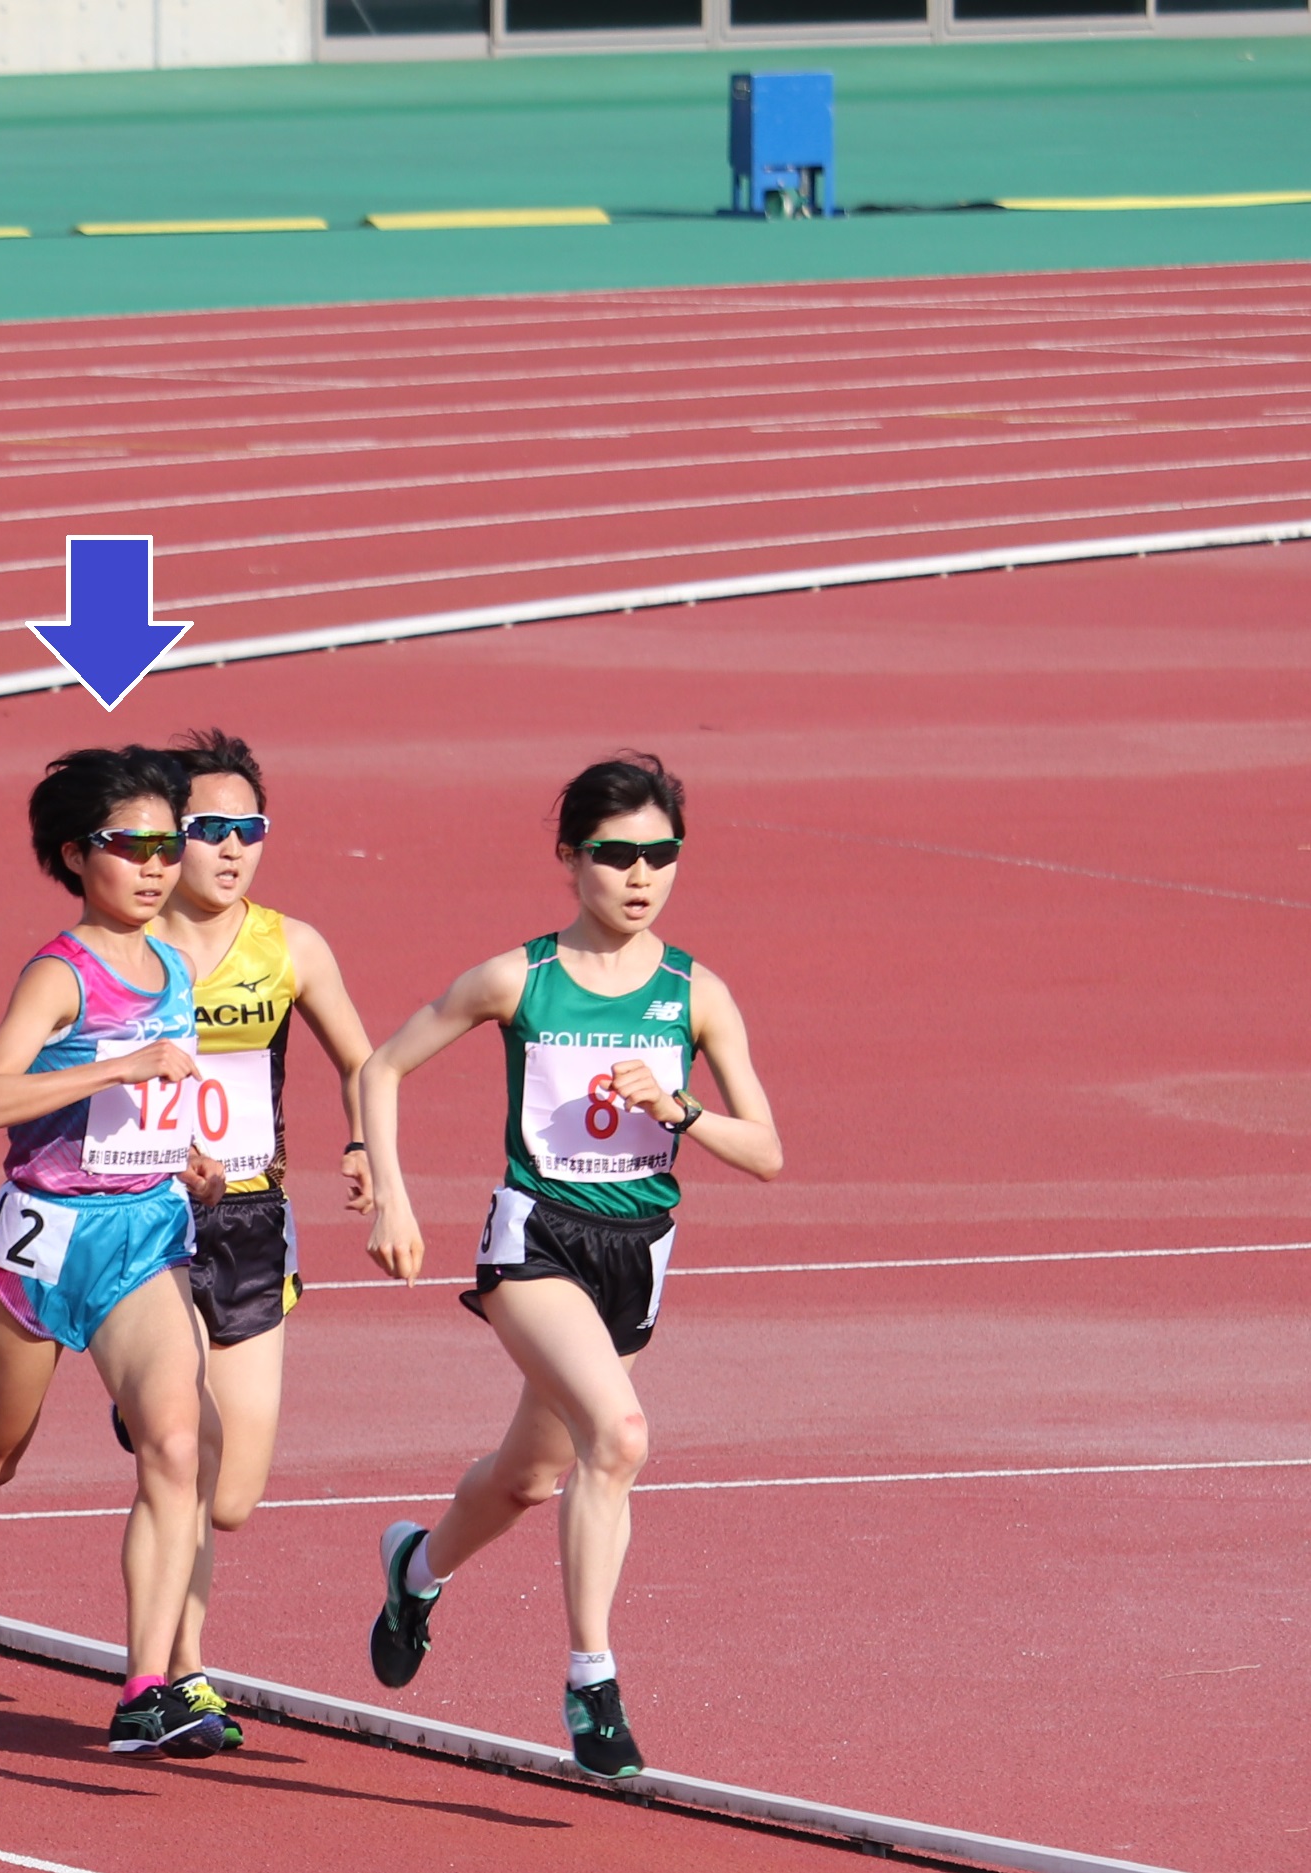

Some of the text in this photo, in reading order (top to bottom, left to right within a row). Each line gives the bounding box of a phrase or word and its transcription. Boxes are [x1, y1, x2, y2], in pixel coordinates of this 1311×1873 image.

[539, 1031, 673, 1048] ROUTE INN
[134, 1079, 183, 1131] 12
[585, 1073, 619, 1140] 8
